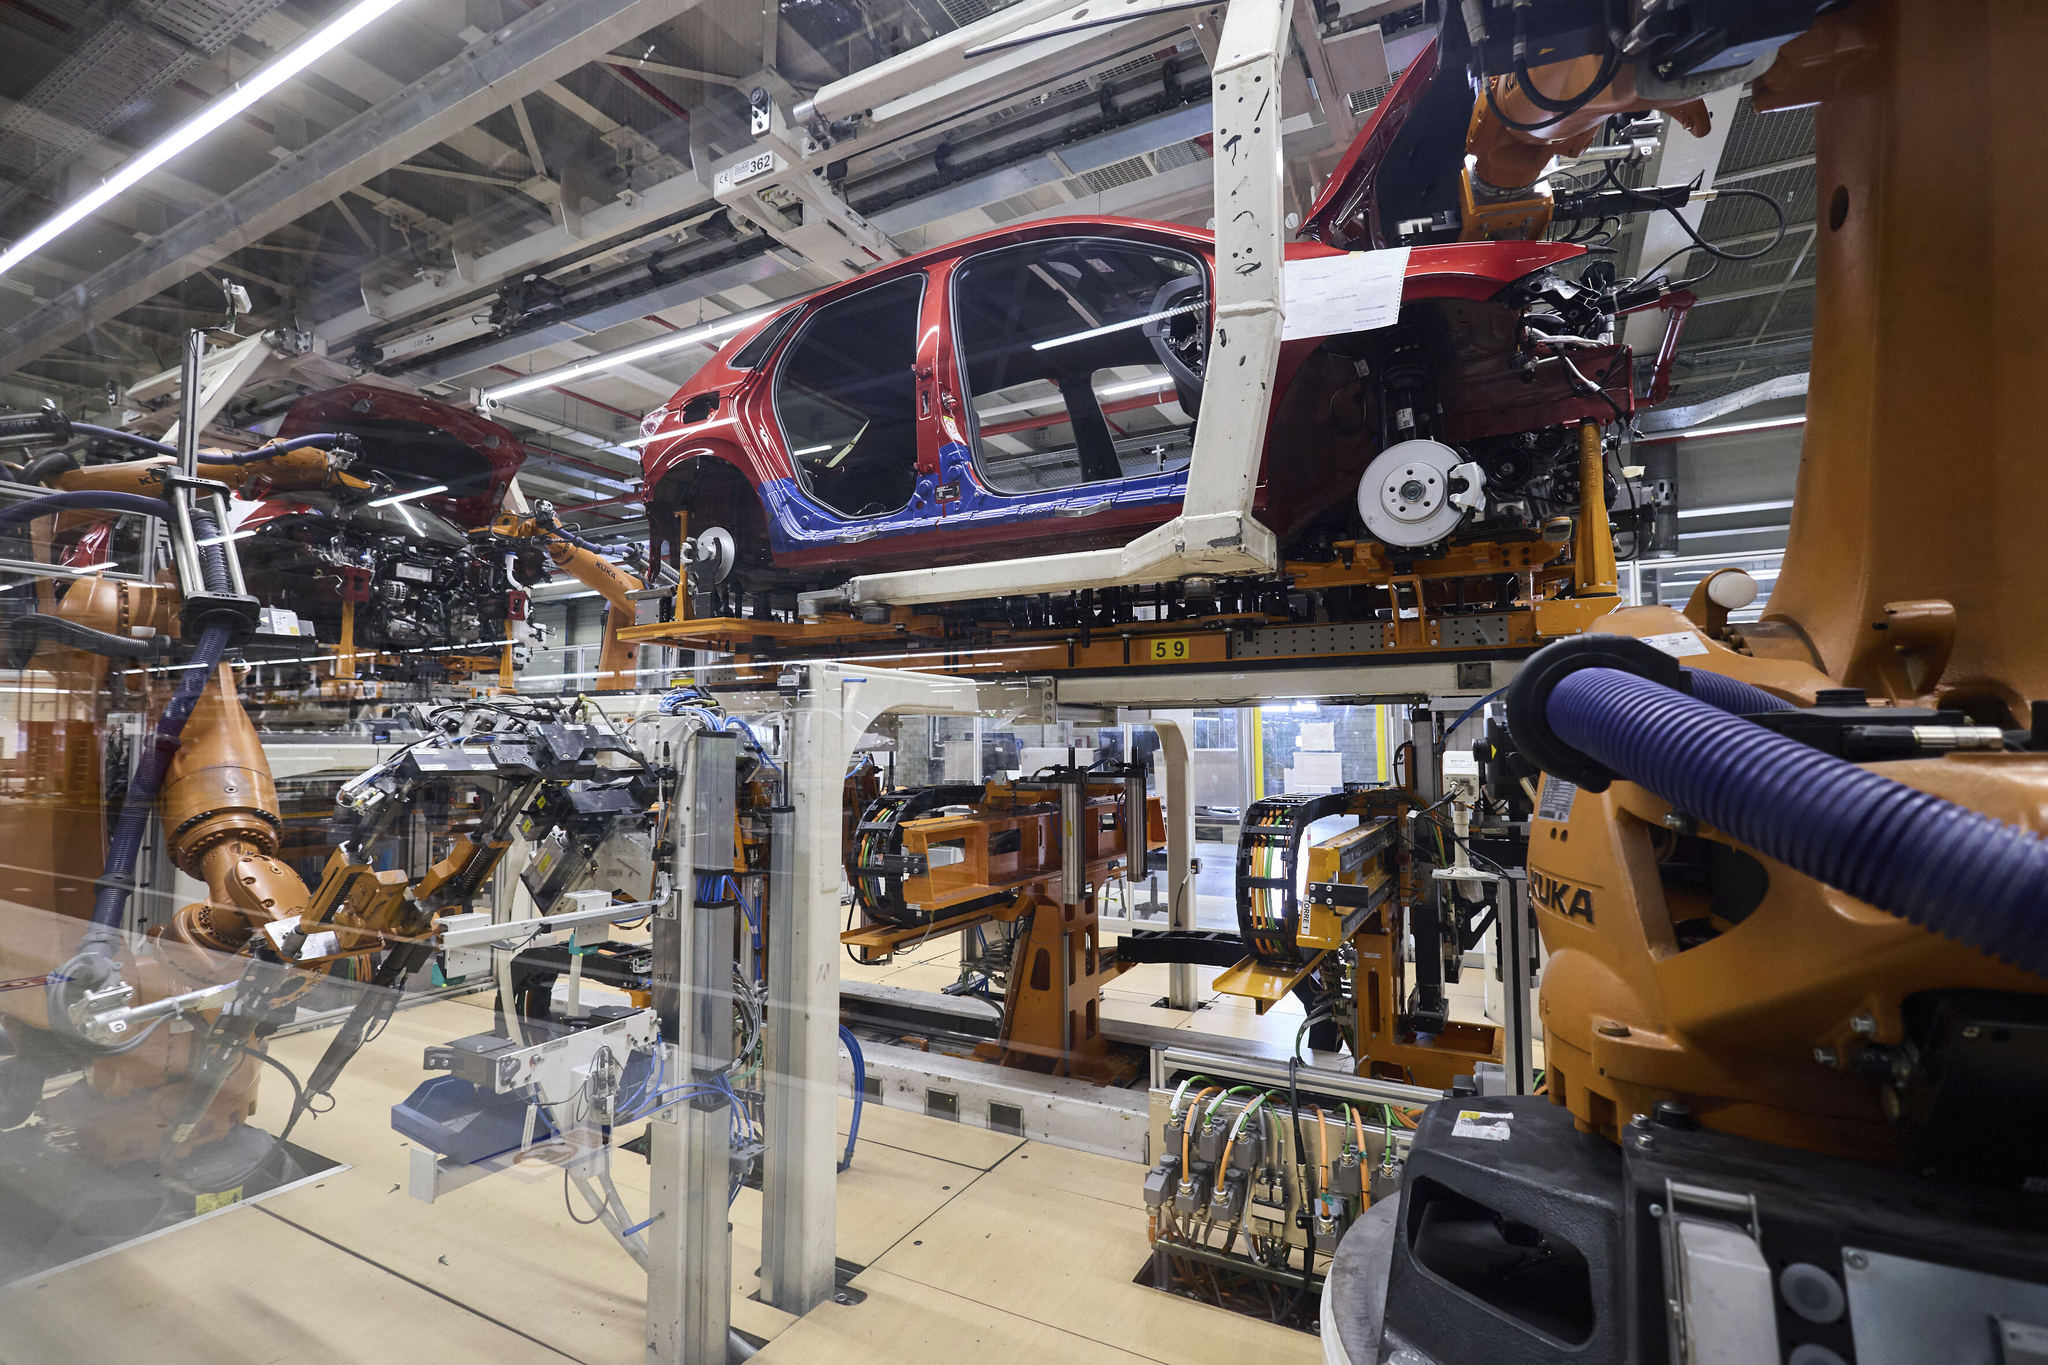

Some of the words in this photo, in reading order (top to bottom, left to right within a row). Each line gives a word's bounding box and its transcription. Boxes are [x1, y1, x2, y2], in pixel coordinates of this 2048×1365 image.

[750, 155, 771, 173] 362
[596, 561, 616, 579] KUKA
[1529, 868, 1595, 926] KUKA
